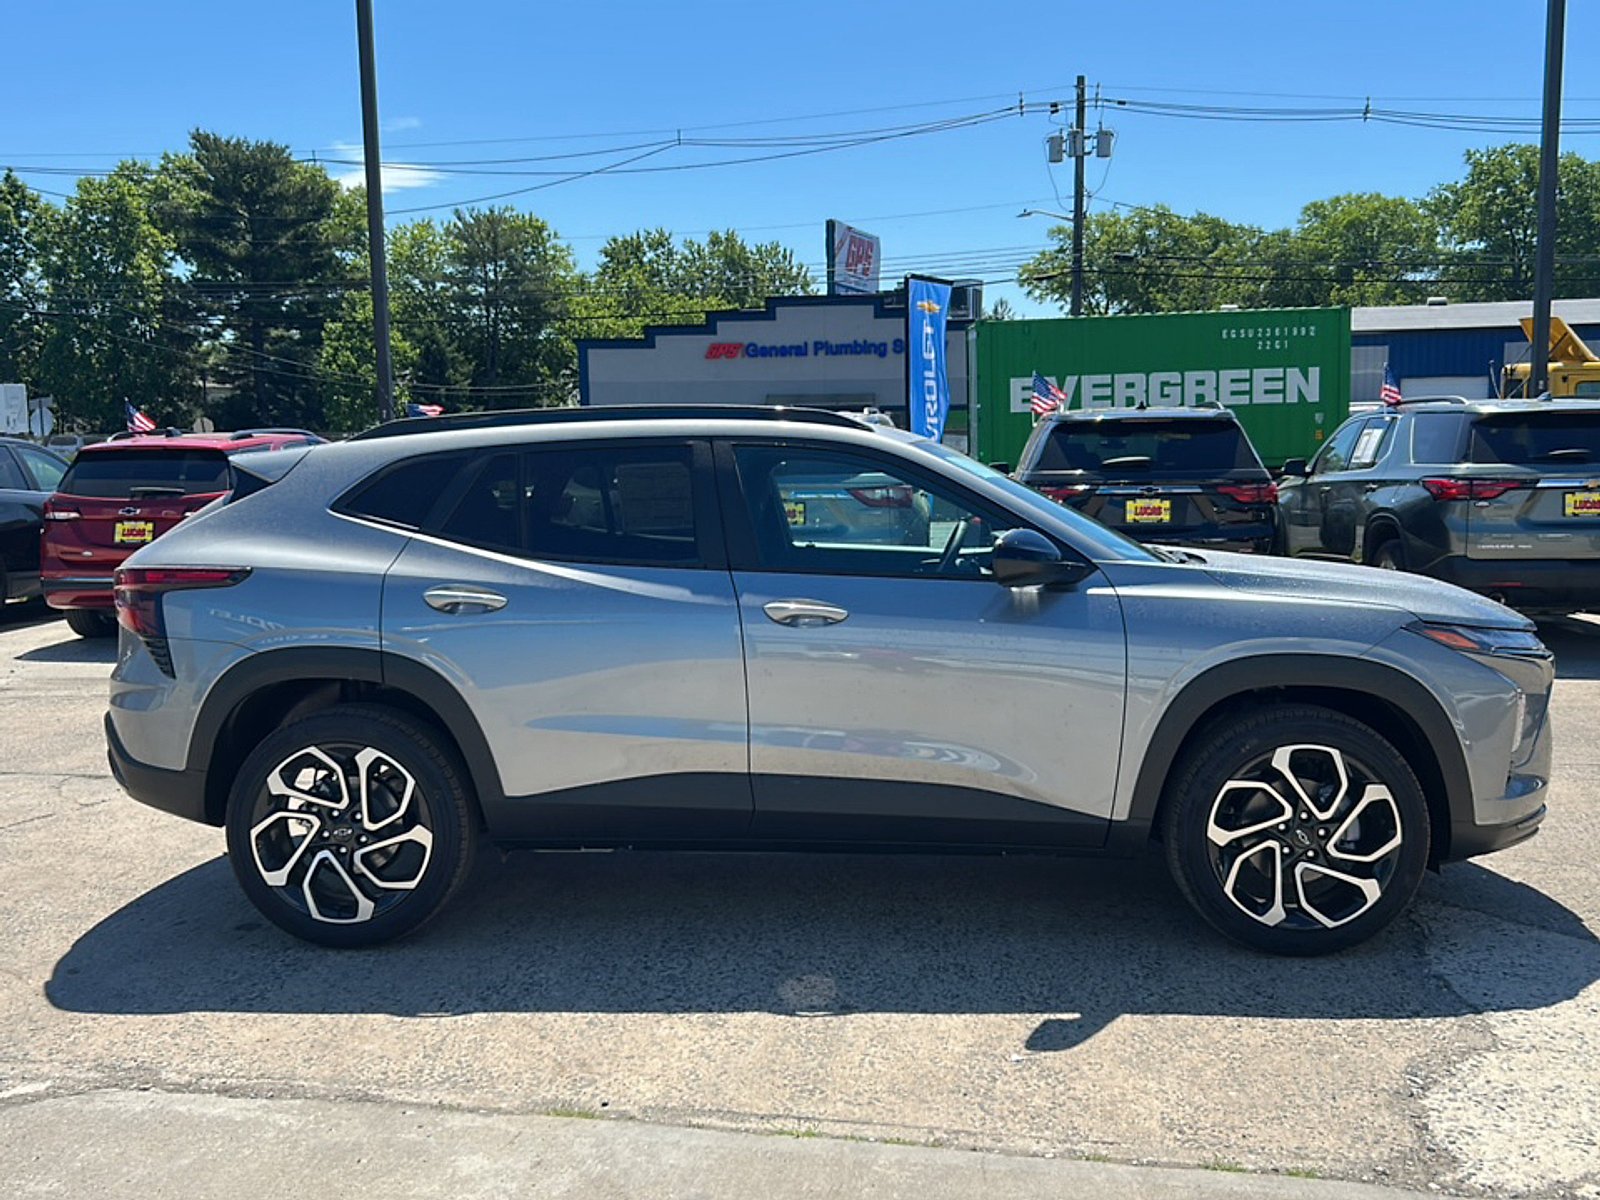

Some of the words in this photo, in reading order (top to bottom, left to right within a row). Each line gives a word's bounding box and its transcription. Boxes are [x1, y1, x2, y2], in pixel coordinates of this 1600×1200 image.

[846, 235, 874, 277] GPS
[745, 341, 808, 359] General
[813, 338, 888, 358] Plumbing
[1009, 366, 1321, 414] EVERGREEN
